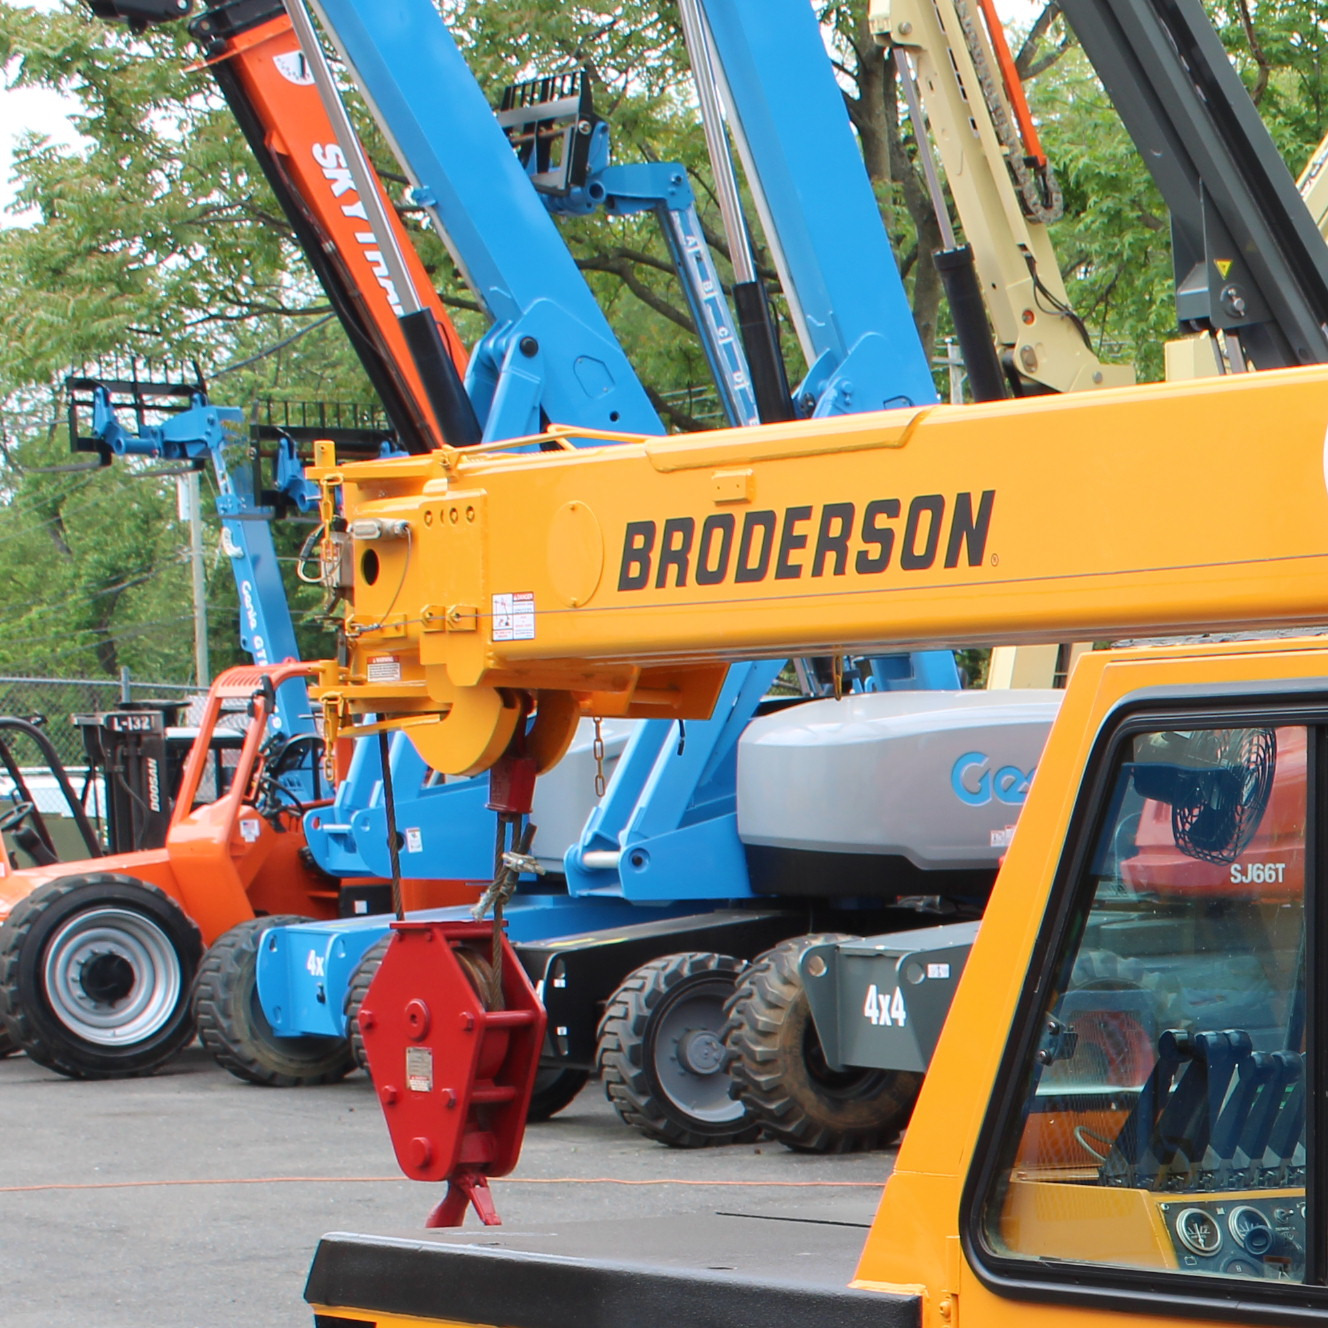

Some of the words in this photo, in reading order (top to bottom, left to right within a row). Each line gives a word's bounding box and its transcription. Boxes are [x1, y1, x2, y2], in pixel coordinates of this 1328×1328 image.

[617, 490, 996, 592] BRODERSON
[146, 756, 161, 812] DOOSAN
[951, 751, 1038, 806] Ge
[1230, 863, 1286, 884] SJ66T
[863, 984, 907, 1027] 4x4
